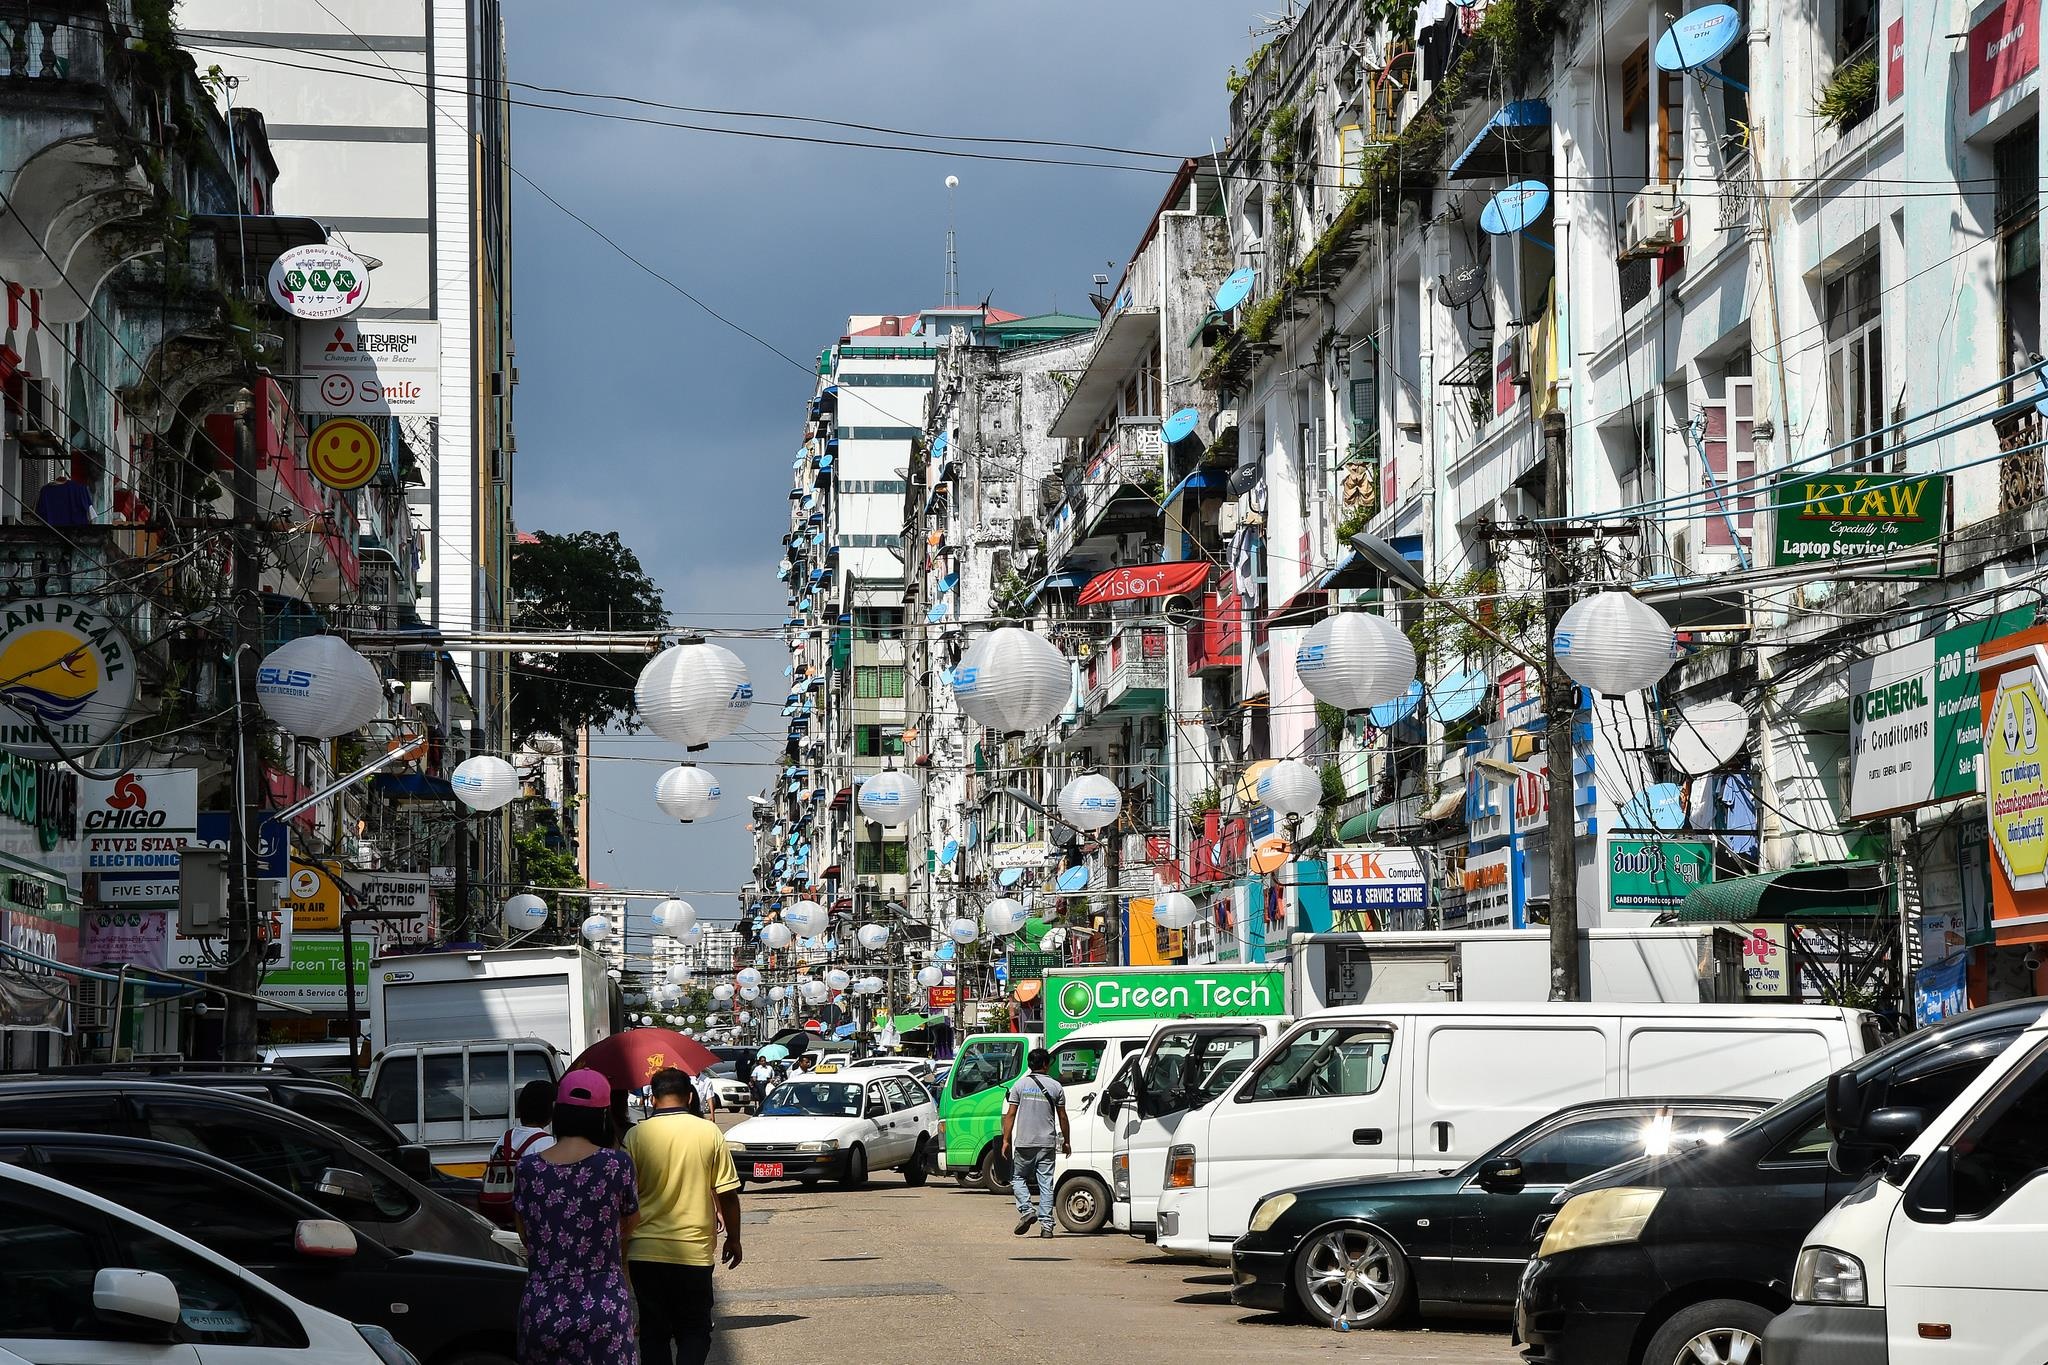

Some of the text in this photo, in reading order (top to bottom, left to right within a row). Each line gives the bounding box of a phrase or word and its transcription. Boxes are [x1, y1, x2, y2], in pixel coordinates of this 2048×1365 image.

[1985, 22, 2025, 63] lenovo
[278, 252, 296, 266] Studio
[305, 248, 328, 256] Beauty
[335, 251, 355, 264] Health
[288, 272, 354, 288] Ri Ra Ku
[297, 306, 343, 318] 09-421577117
[356, 334, 417, 344] MITSUBISHI
[356, 343, 409, 353] ELECTRIC
[324, 353, 417, 364] Changes for the Better
[359, 381, 421, 403] Smile
[1803, 478, 1929, 517] KYAW
[1829, 521, 1899, 537] Especially For
[1783, 539, 1829, 559] Laptop
[1833, 540, 1885, 556] Service
[55, 602, 125, 682] PEARL
[1938, 650, 1962, 682] 200
[258, 668, 312, 688] SUS
[1865, 675, 1929, 723] GENERAL
[1937, 702, 1948, 719] Air
[1853, 719, 1929, 756] Air Conditioners
[1956, 725, 1981, 746] Washing
[1958, 758, 1972, 776] Sale
[2000, 768, 2014, 784] ICT
[84, 809, 167, 829] CHIGO
[90, 838, 140, 852] FIVE
[141, 836, 188, 851] STAR
[1332, 853, 1387, 880] KK
[1388, 867, 1423, 880] Computer
[112, 884, 180, 896] FIVE STAR
[361, 882, 427, 895] MITSUBISHI
[1332, 887, 1423, 905] SALES & SERVICE CENTRE
[308, 902, 326, 913] AIR
[1615, 896, 1633, 904] SABEI
[291, 959, 326, 972] reen
[259, 988, 296, 997] howroom
[297, 989, 304, 997] &
[306, 987, 336, 998] Service
[1095, 979, 1271, 1008] Green Tech
[1755, 981, 1780, 993] Copy
[1062, 1053, 1076, 1062] UPS
